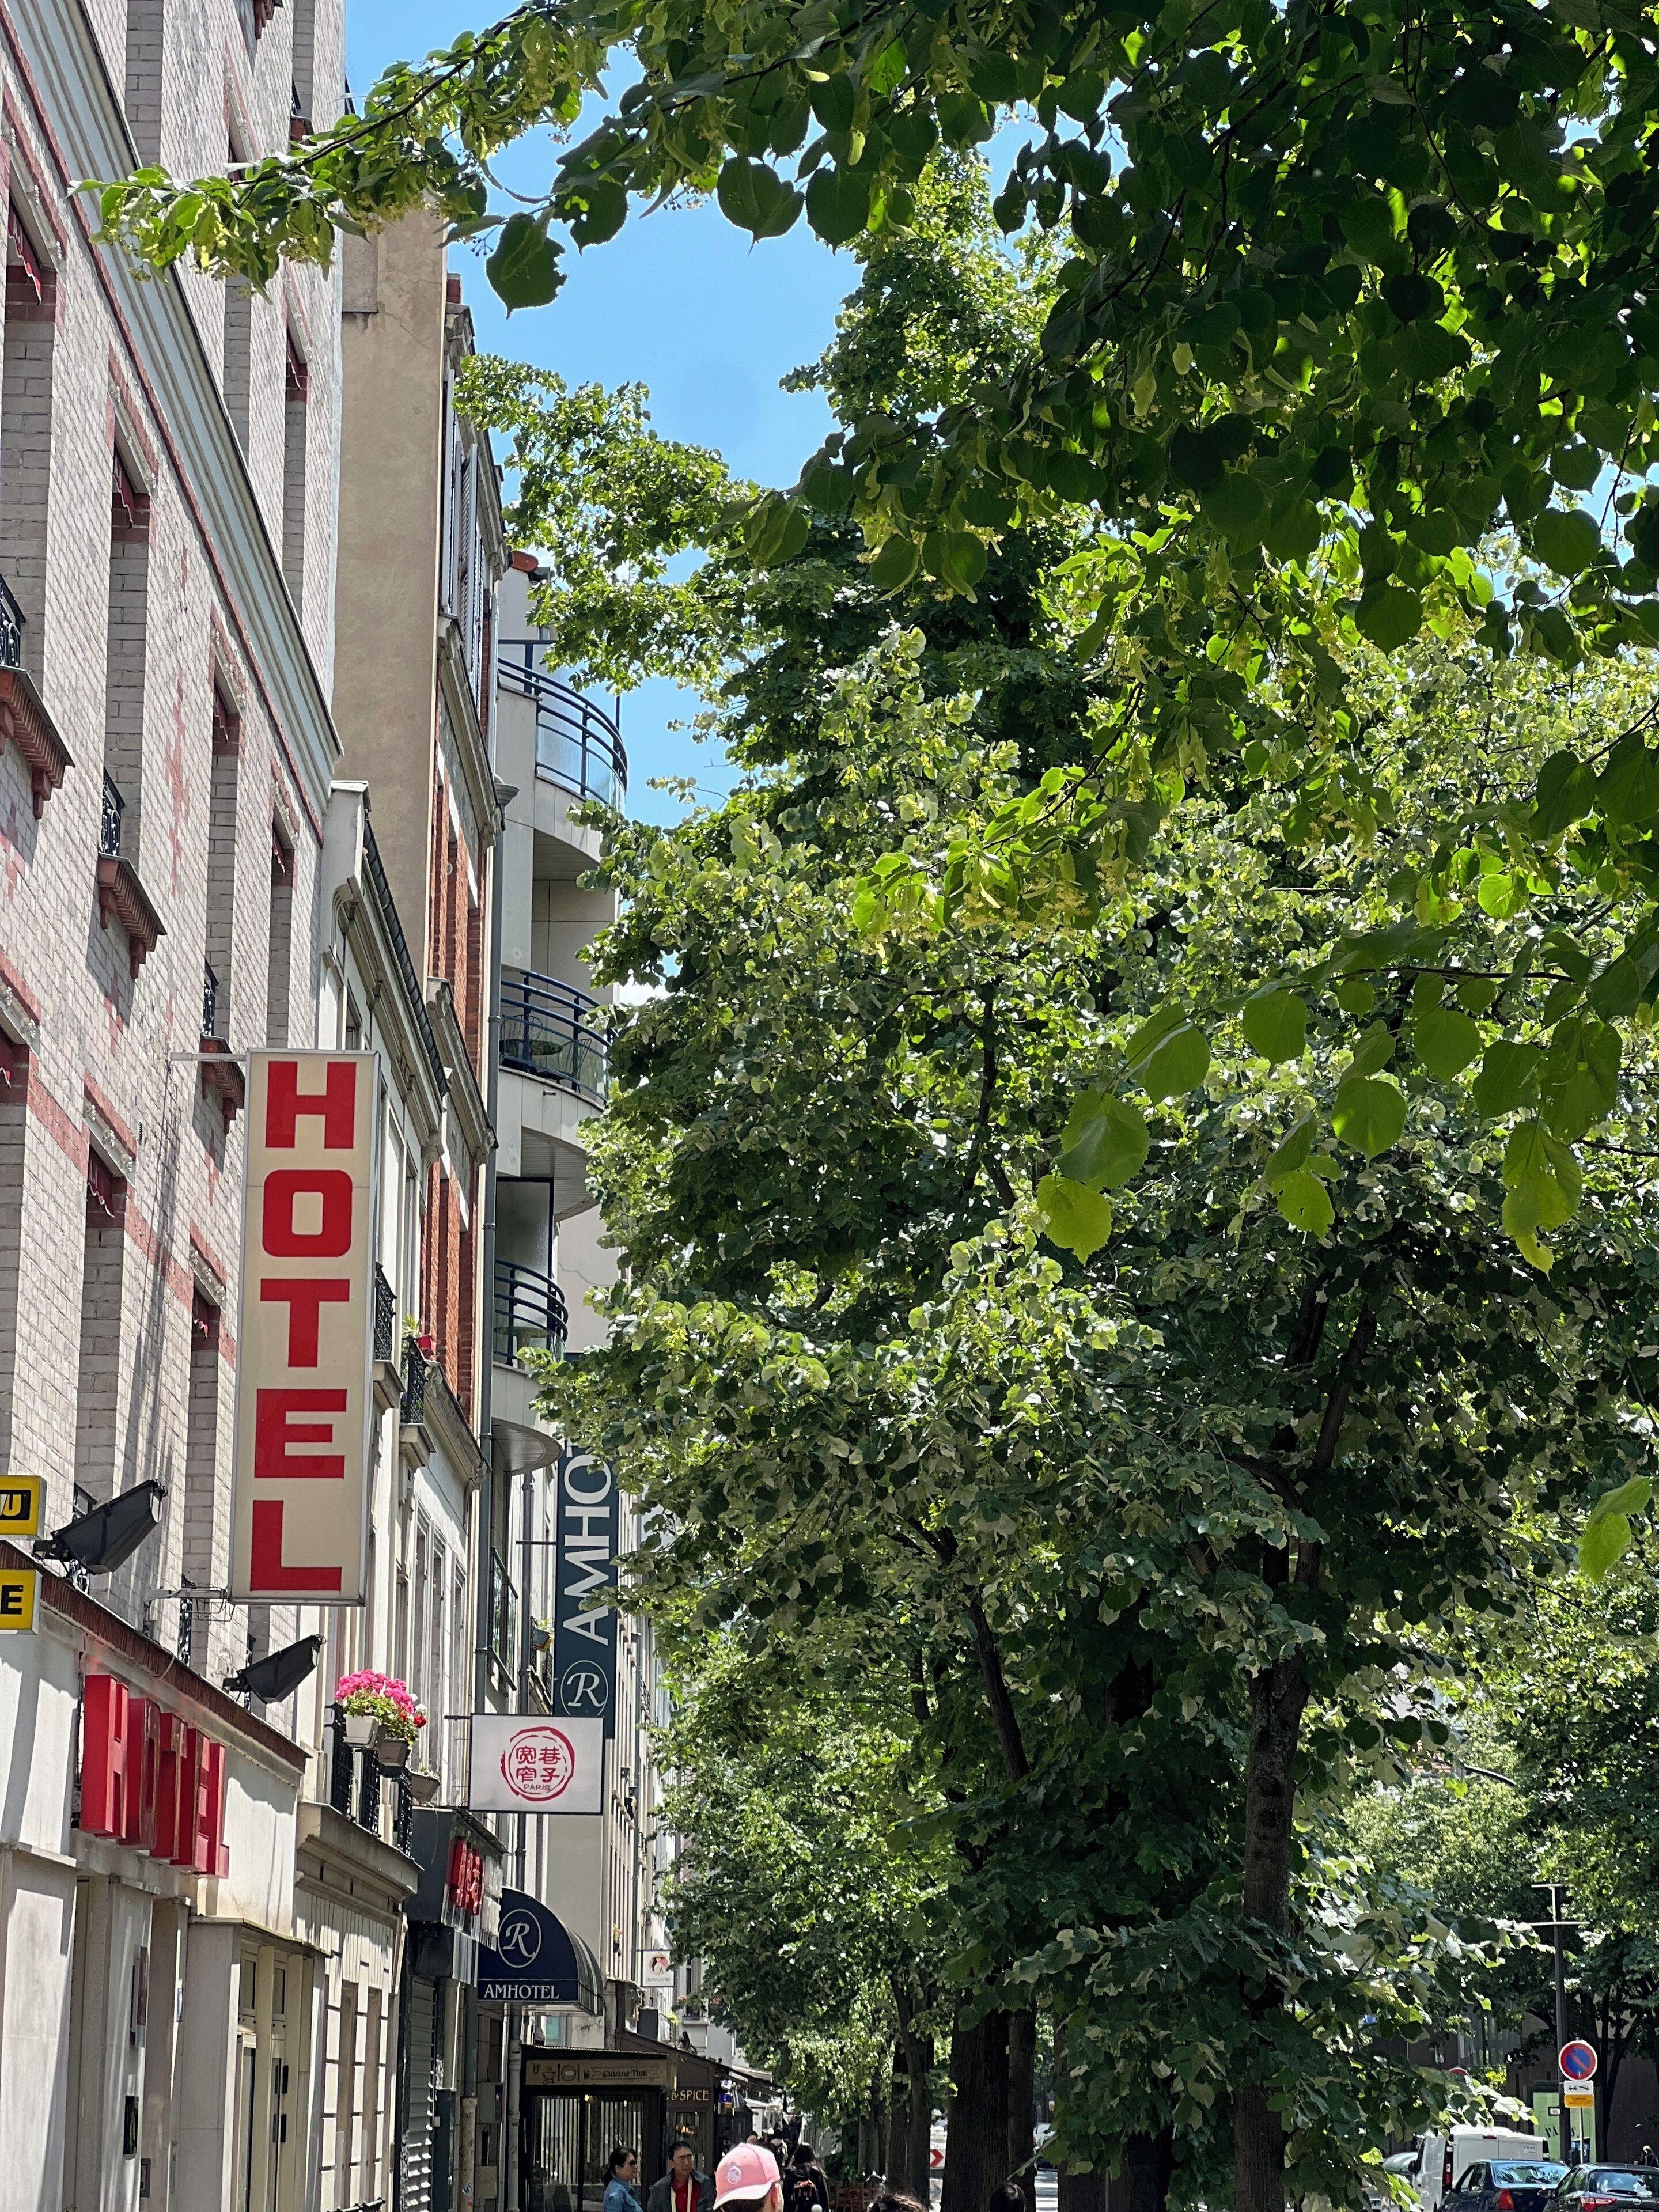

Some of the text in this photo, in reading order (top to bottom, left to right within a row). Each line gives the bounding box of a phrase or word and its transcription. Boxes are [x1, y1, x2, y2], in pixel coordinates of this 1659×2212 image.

[250, 1060, 357, 1591] HOTEL
[566, 1672, 605, 1707] R
[524, 1783, 551, 1791] PARIS
[502, 1922, 536, 1958] R
[483, 1984, 560, 1999] AMHOTEL
[603, 2069, 647, 2077] Cuisine Thai
